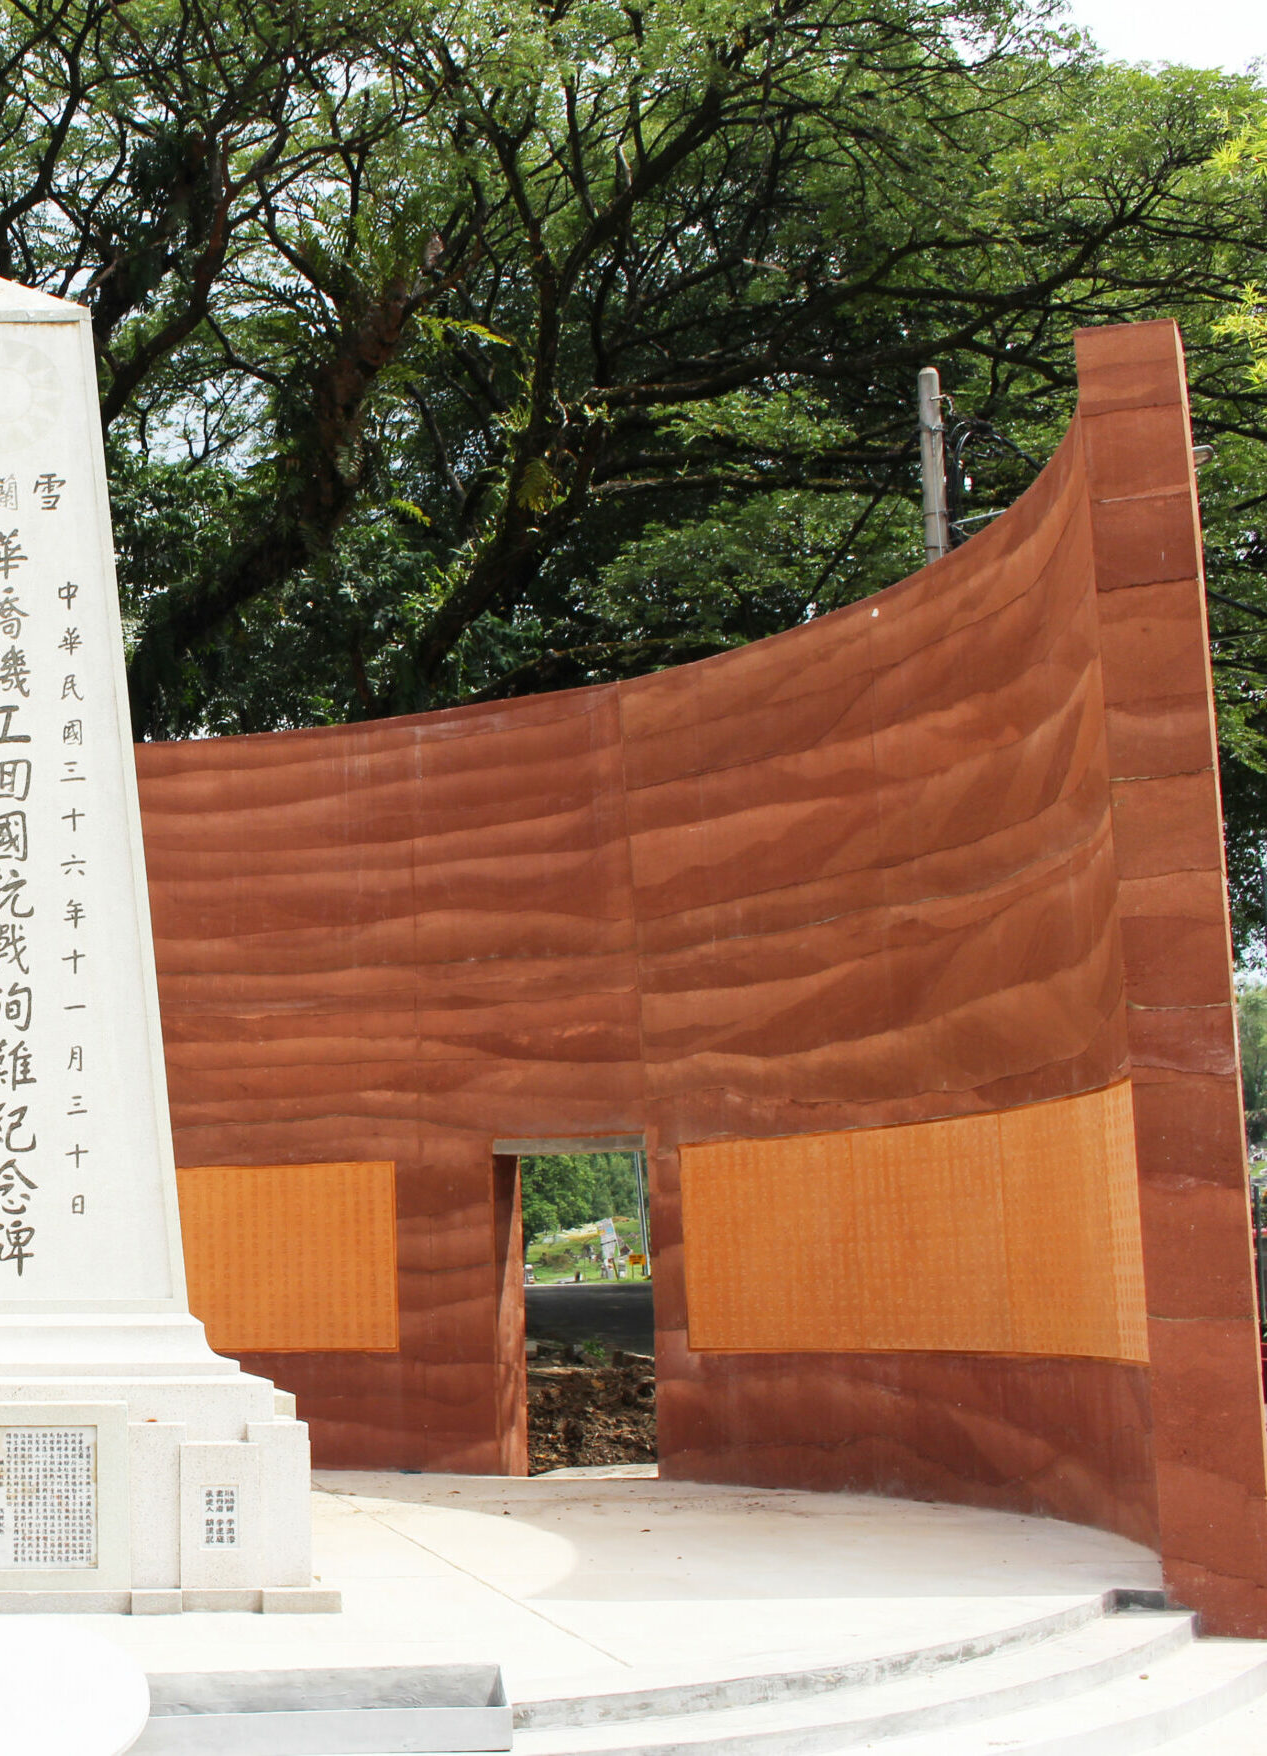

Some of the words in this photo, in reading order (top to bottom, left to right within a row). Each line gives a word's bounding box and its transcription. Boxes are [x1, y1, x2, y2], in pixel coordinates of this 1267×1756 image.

[58, 581, 89, 1215] 中華民國三十六年十一月三十日
